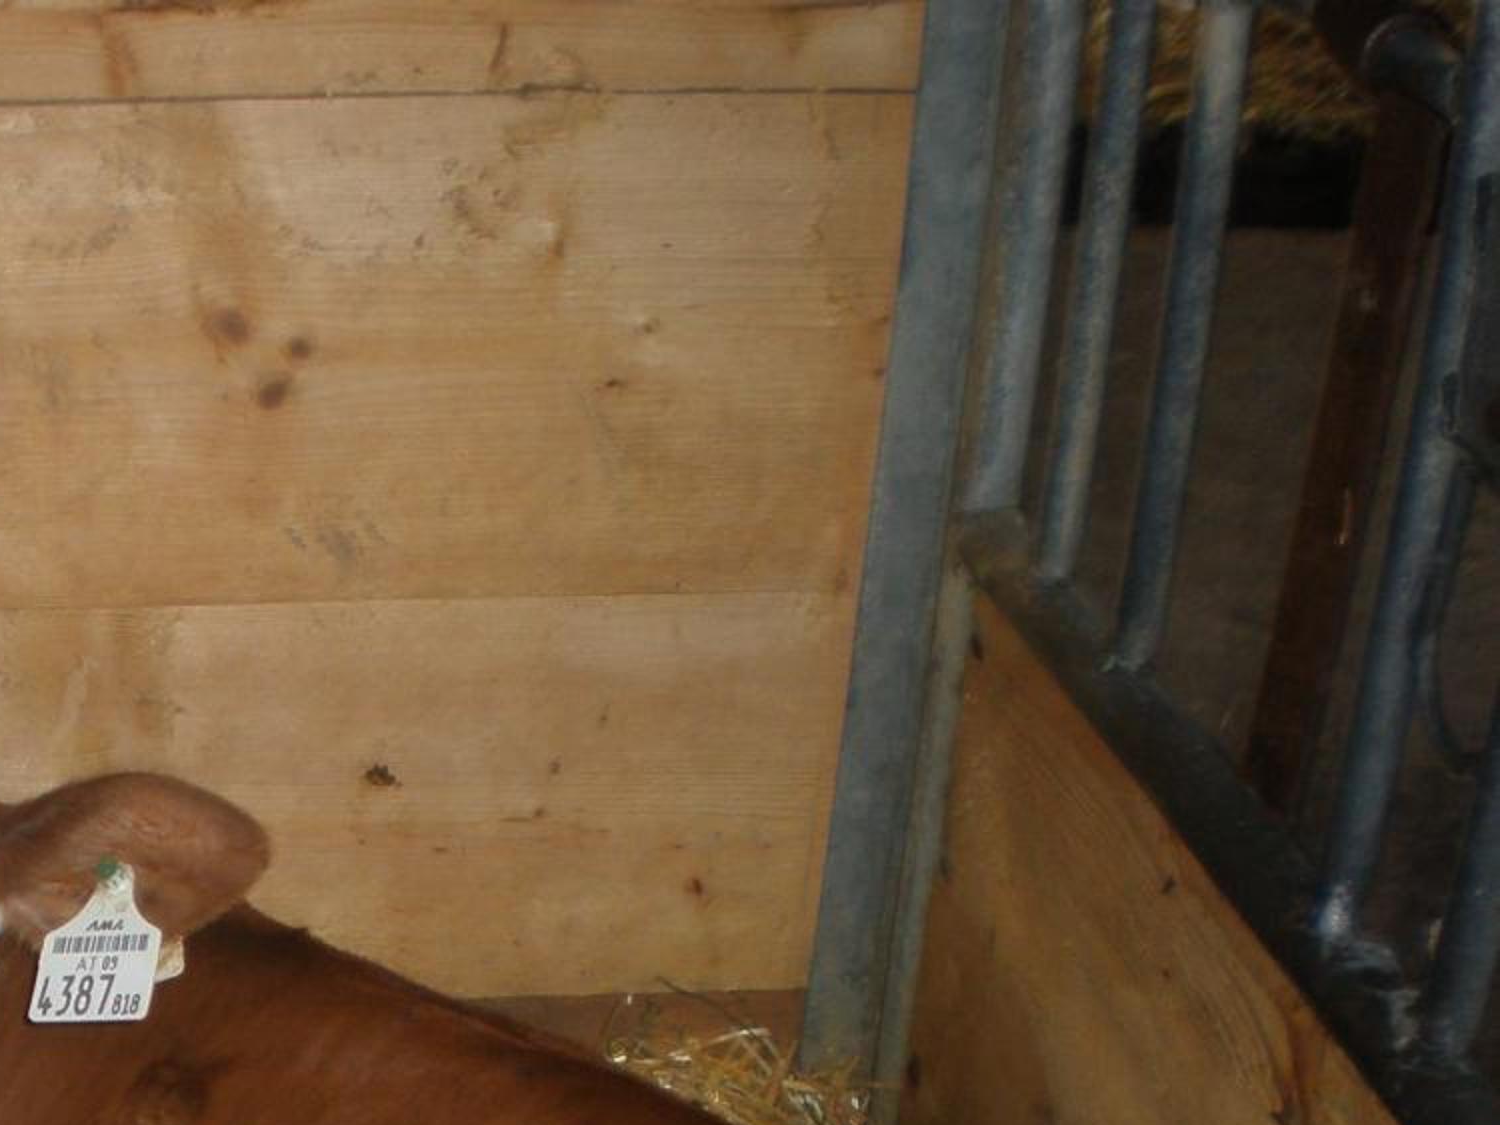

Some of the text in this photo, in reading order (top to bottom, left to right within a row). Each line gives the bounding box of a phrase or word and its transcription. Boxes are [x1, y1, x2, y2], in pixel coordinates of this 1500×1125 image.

[76, 955, 119, 972] AT 09
[37, 975, 141, 1016] 4387 818
